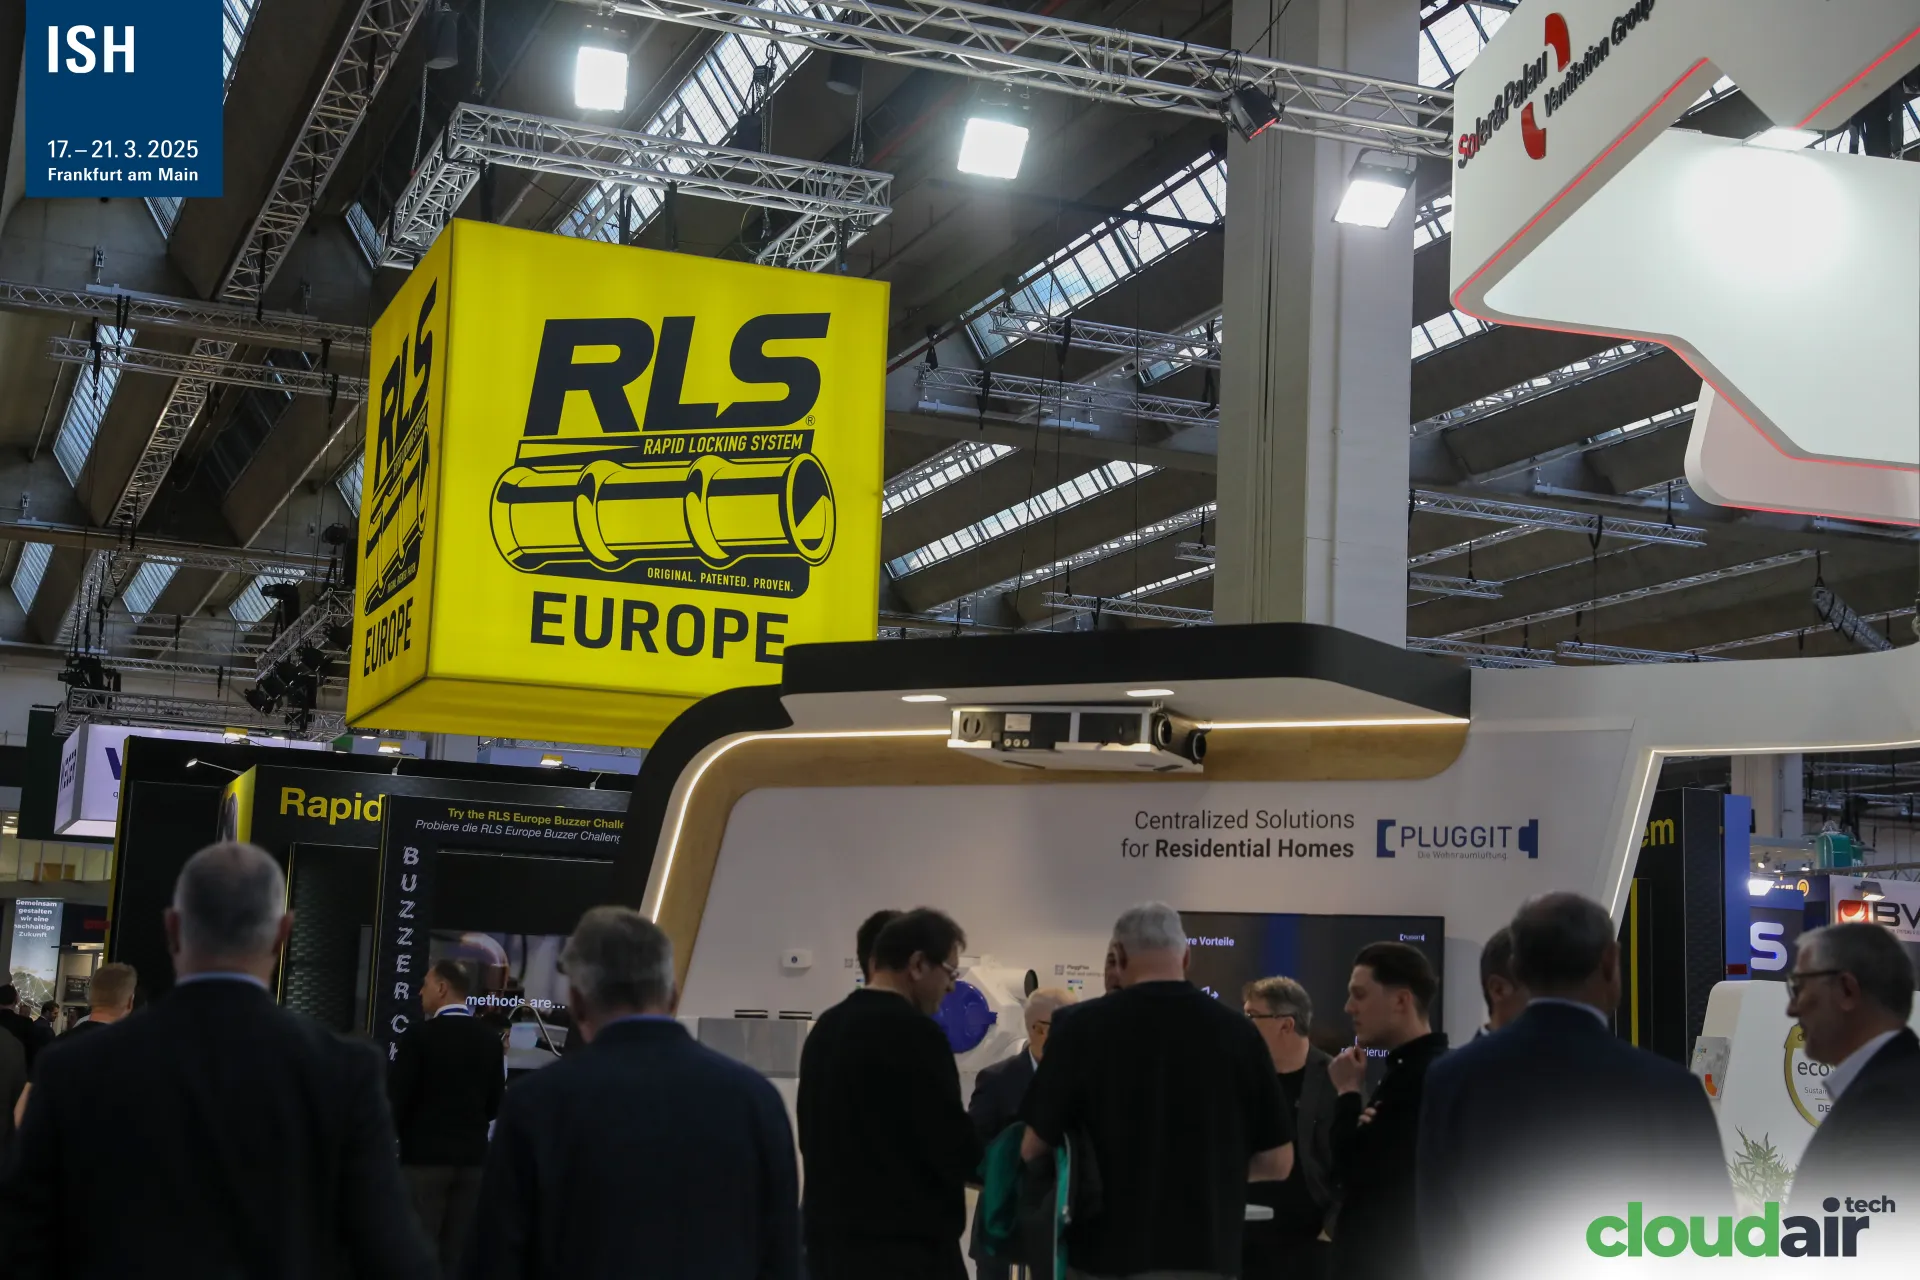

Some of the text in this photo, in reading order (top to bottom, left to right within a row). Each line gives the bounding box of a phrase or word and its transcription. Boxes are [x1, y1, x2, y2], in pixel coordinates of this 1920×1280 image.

[1544, 0, 1655, 118] Ventilation Group
[374, 276, 438, 492] RLS
[523, 312, 831, 437] RLS
[643, 433, 804, 455] RAPID LOCKING SYSTEM
[647, 567, 794, 592] ORIGINAL. PATENTED. PROVEN.
[363, 596, 414, 678] EUROPE
[530, 590, 789, 665] EUROPE
[279, 786, 386, 825] Rapid
[448, 807, 465, 819] Try
[467, 809, 485, 820] the
[488, 811, 510, 822] RLS
[513, 813, 551, 826] Europe
[554, 815, 591, 828] Buzzer
[1134, 809, 1355, 830] Centralized Solutions
[415, 819, 459, 831] Probiere
[461, 822, 478, 832] die
[480, 824, 503, 835] RLS
[505, 826, 542, 839] Europe
[544, 828, 578, 840] Buzzer
[1400, 826, 1513, 848] PLUGGIT
[1121, 837, 1355, 858] for Residential Homes
[15, 899, 57, 907] Gemeinsam
[1199, 936, 1235, 946] Vorteile
[465, 994, 526, 1007] methods
